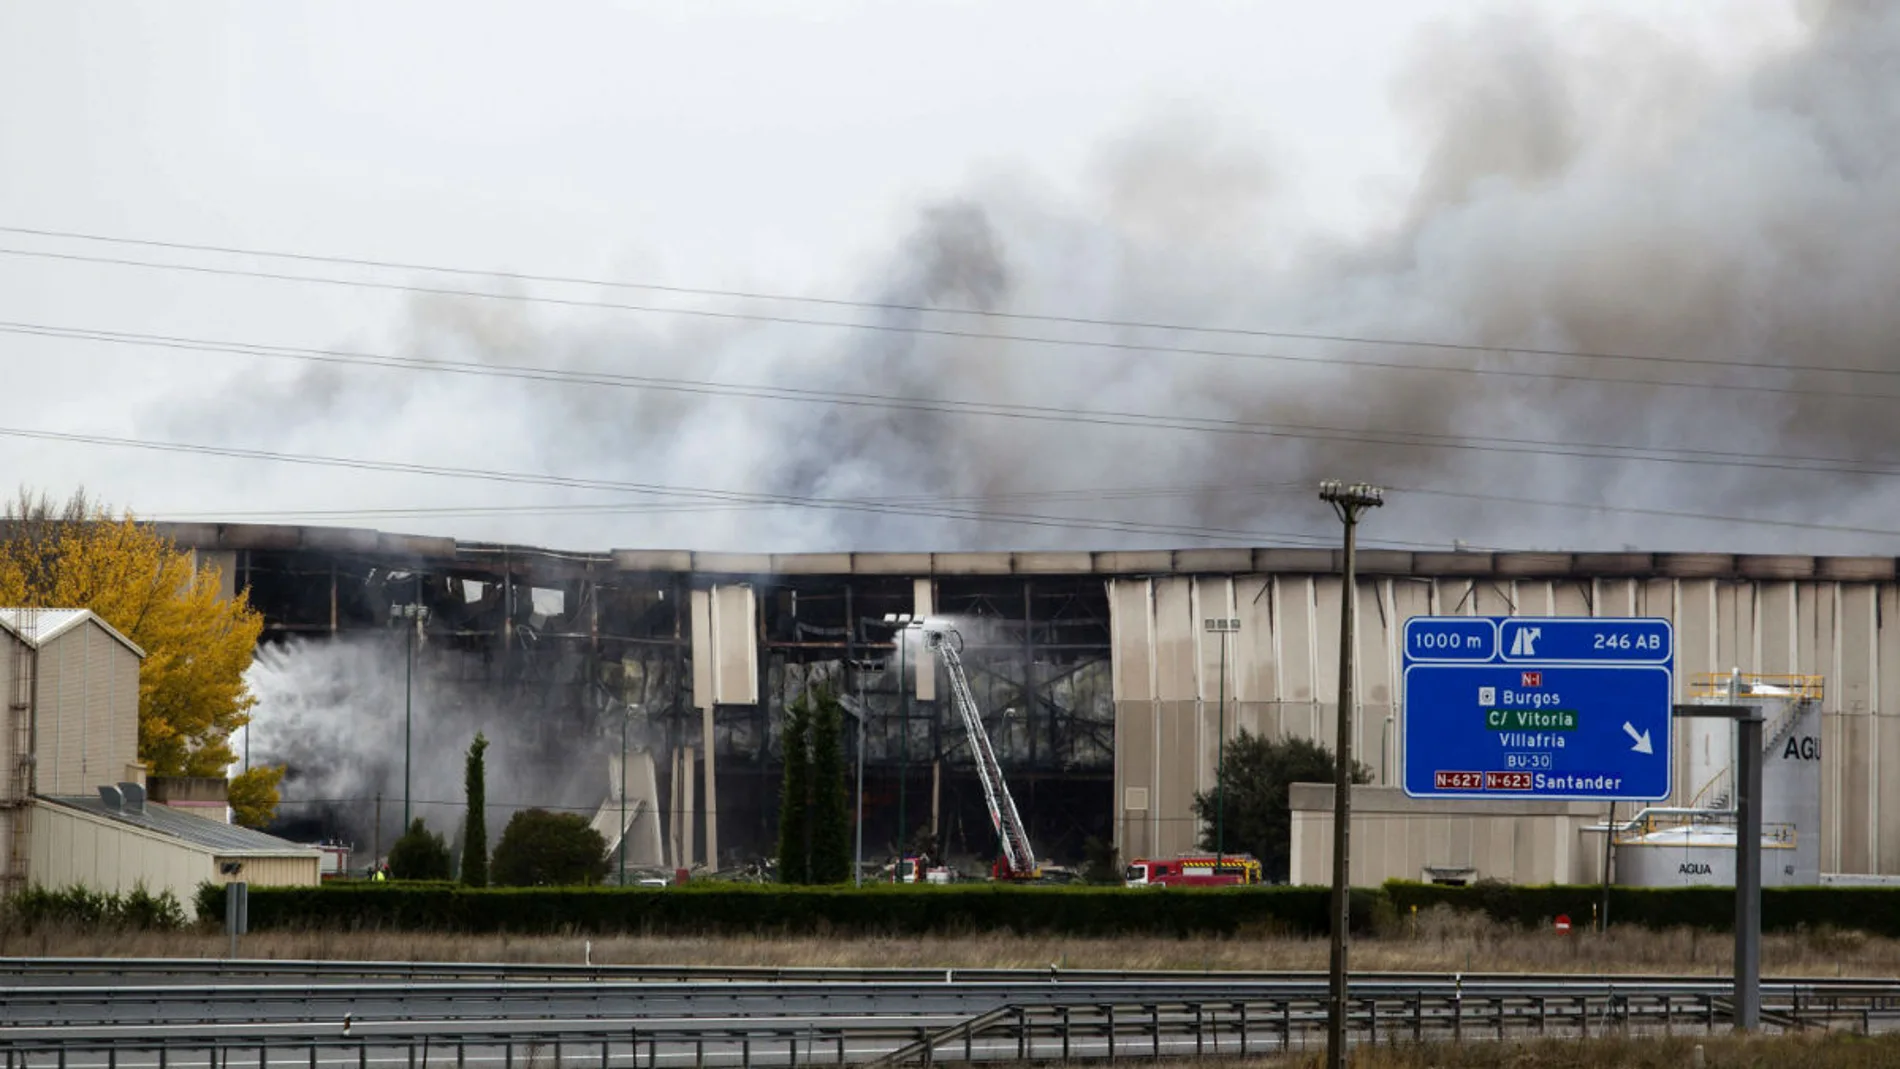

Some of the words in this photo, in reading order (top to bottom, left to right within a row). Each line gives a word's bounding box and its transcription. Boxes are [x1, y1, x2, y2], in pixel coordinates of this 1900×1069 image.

[1415, 633, 1461, 649] 1000
[1467, 637, 1482, 649] m
[1593, 634, 1631, 650] 246
[1635, 635, 1661, 650] AB
[1503, 690, 1560, 708] Burgos
[1489, 711, 1507, 726] C/
[1516, 711, 1573, 727] Vitoria
[1508, 755, 1549, 768] BU-30
[1436, 773, 1481, 787] N-627
[1487, 774, 1531, 788] N-623
[1535, 773, 1622, 790] Santander
[1678, 863, 1712, 875] AGUA
